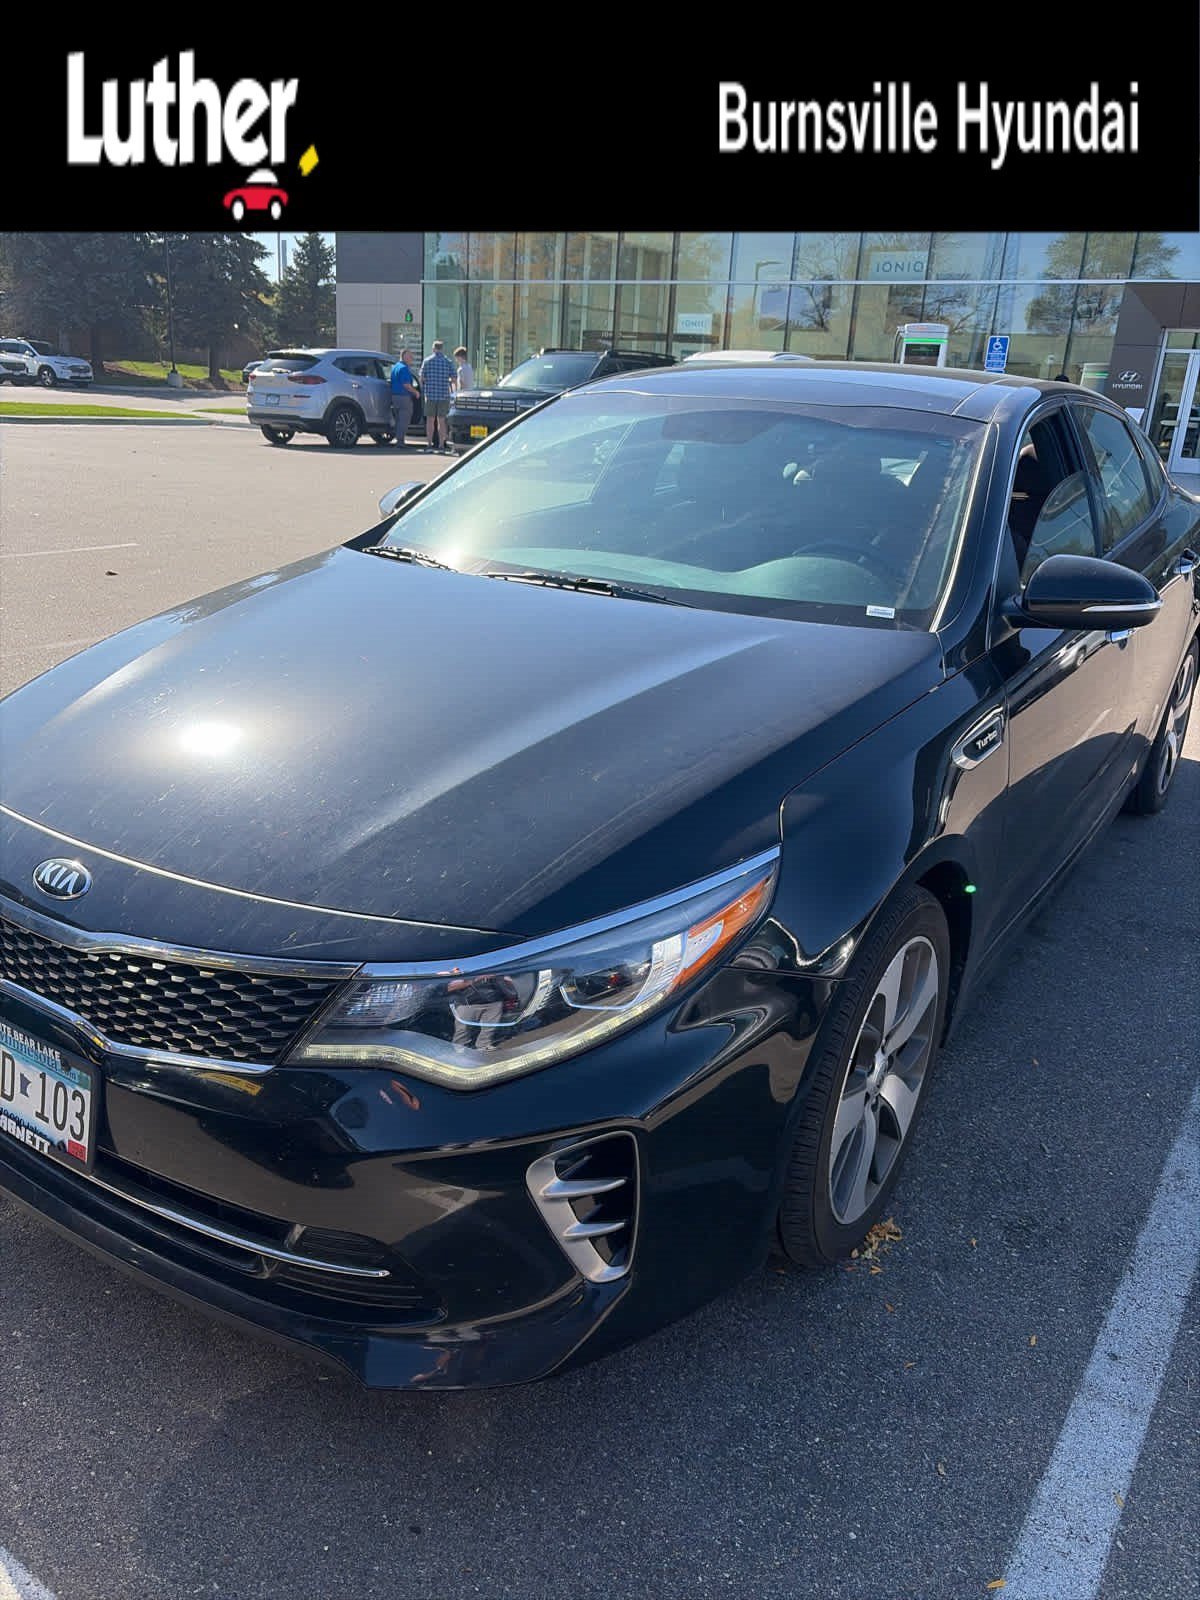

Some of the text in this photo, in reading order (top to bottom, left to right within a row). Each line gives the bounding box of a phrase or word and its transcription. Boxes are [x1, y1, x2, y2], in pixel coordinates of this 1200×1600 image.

[876, 261, 924, 273] IONIQ
[976, 729, 998, 750] Turbo
[38, 862, 79, 895] KIA
[13, 1029, 36, 1049] BEAR
[37, 1041, 61, 1062] LAKE
